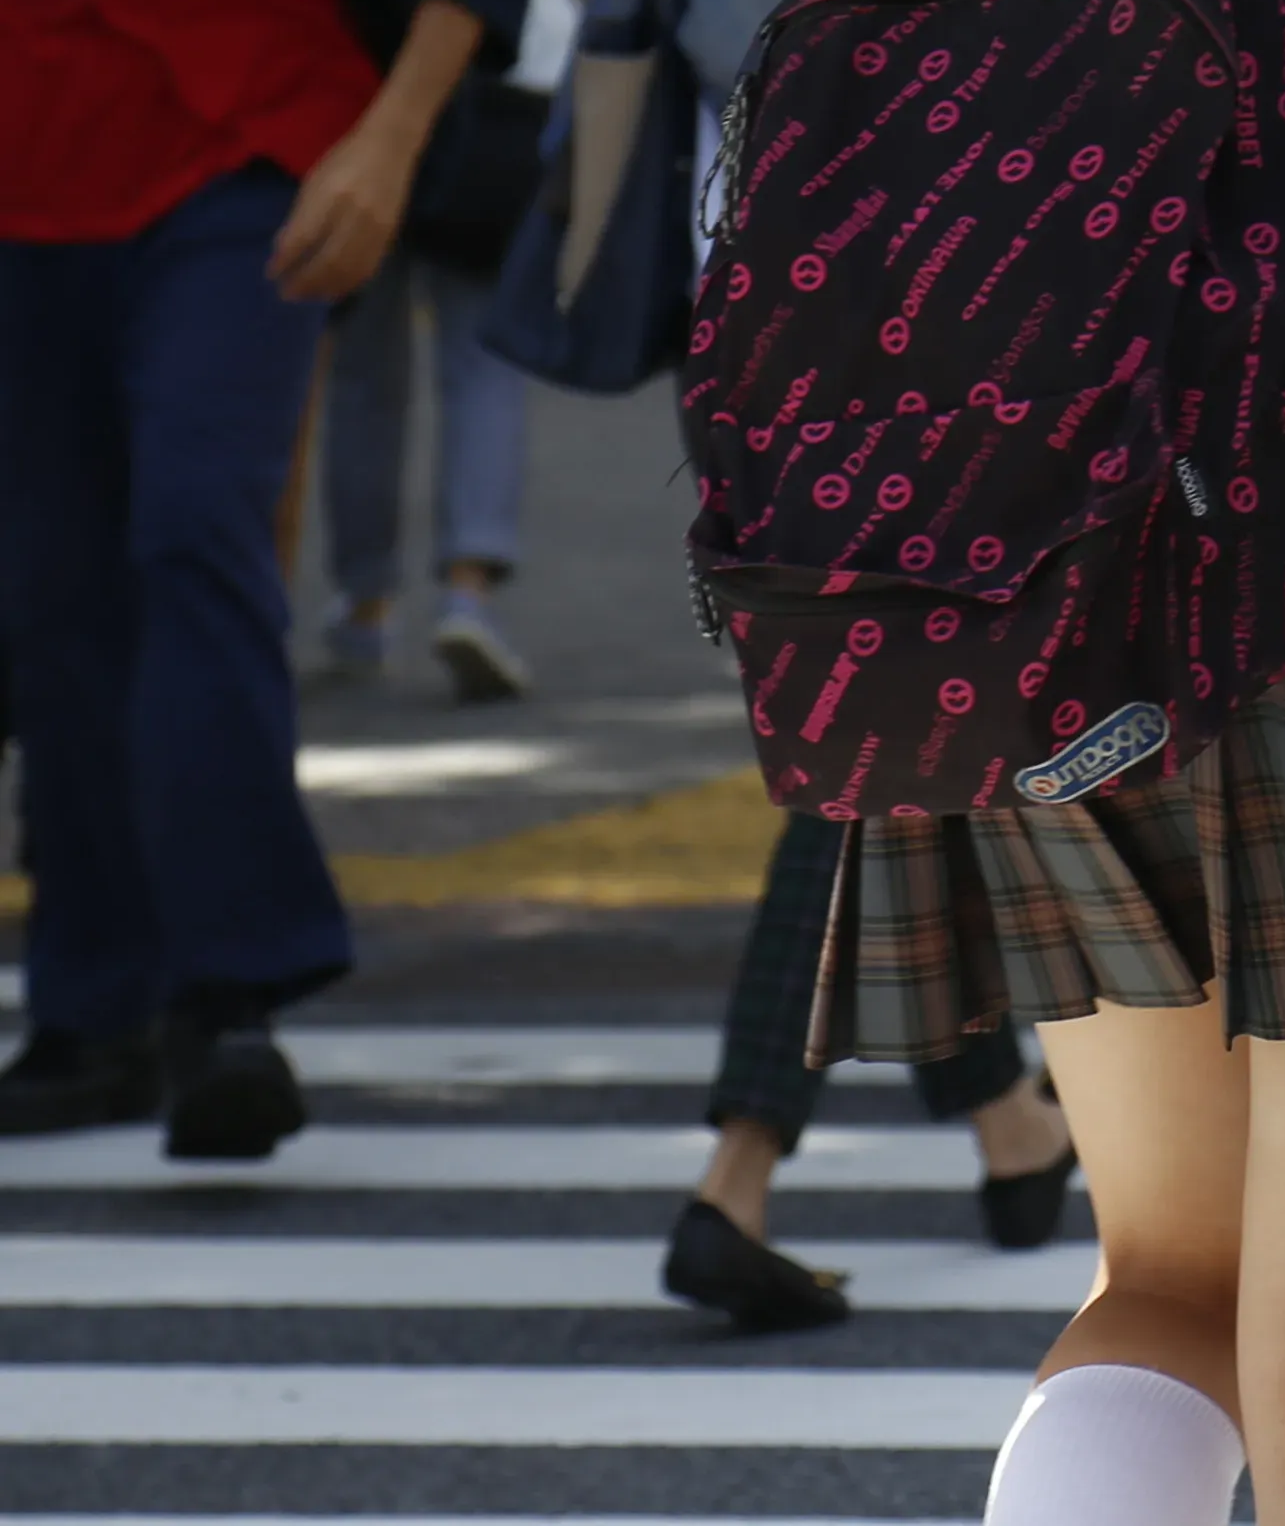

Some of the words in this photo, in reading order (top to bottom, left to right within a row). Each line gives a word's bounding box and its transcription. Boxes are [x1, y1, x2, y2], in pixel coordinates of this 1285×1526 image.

[951, 35, 1007, 102] TIBET
[798, 128, 877, 196] Paulo
[1108, 106, 1190, 200] Dublin
[901, 214, 978, 320] OKINAWA
[960, 233, 1030, 323] Paulo
